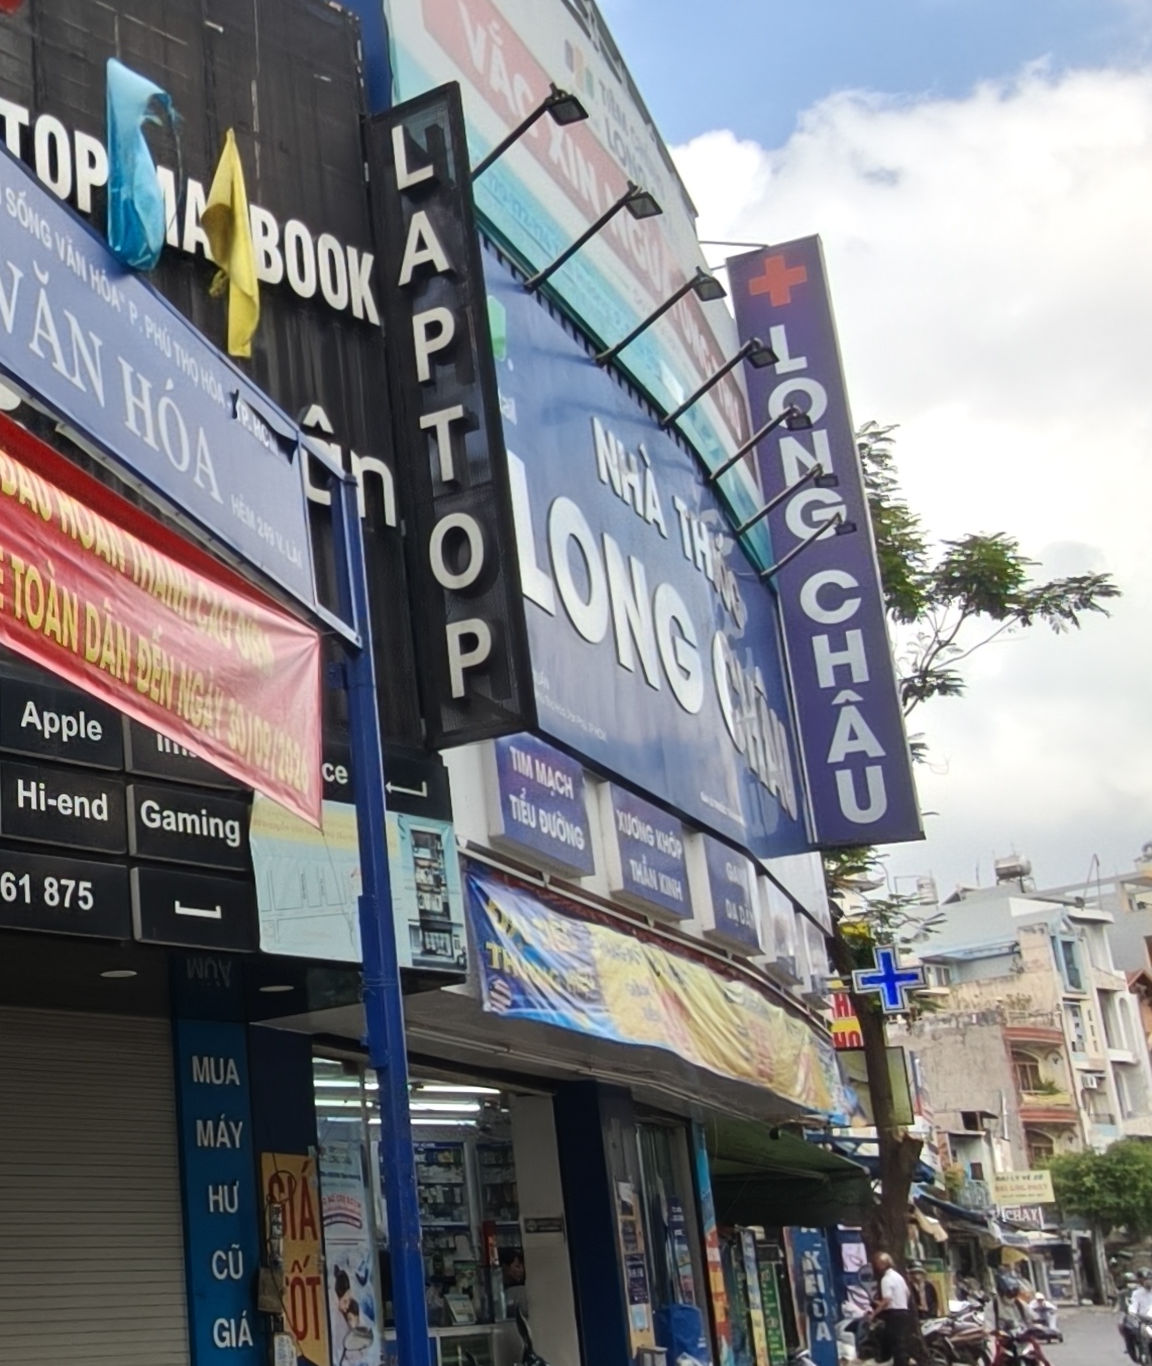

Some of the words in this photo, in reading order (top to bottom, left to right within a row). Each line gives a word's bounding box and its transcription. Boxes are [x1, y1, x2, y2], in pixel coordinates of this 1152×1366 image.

[54, 234, 87, 283] VĂN
[117, 355, 222, 504] HÓA
[392, 125, 492, 699] LAPTOP
[768, 325, 847, 542] LONG
[592, 416, 668, 540] NHÀ
[505, 448, 705, 715] LONG
[11, 554, 80, 656] TOÀN
[84, 598, 131, 685] DÂN
[136, 624, 173, 715] ĐẾN
[799, 569, 888, 824] CHÂU
[20, 700, 103, 742] Apple
[509, 745, 534, 780] TIM
[535, 759, 574, 800] MẠCH
[17, 778, 108, 821] Hi-end
[140, 799, 241, 847] Gaming
[509, 787, 536, 829] TIỂU
[538, 809, 585, 851] ĐƯỜNG
[616, 809, 655, 847] XƯƠNG
[43, 875, 94, 910] 875
[191, 1055, 241, 1086] MUA
[196, 1113, 243, 1149] MÁY
[208, 1181, 240, 1214] HƯ
[211, 1244, 244, 1281] CŨ
[213, 1310, 254, 1349] GIÁ
